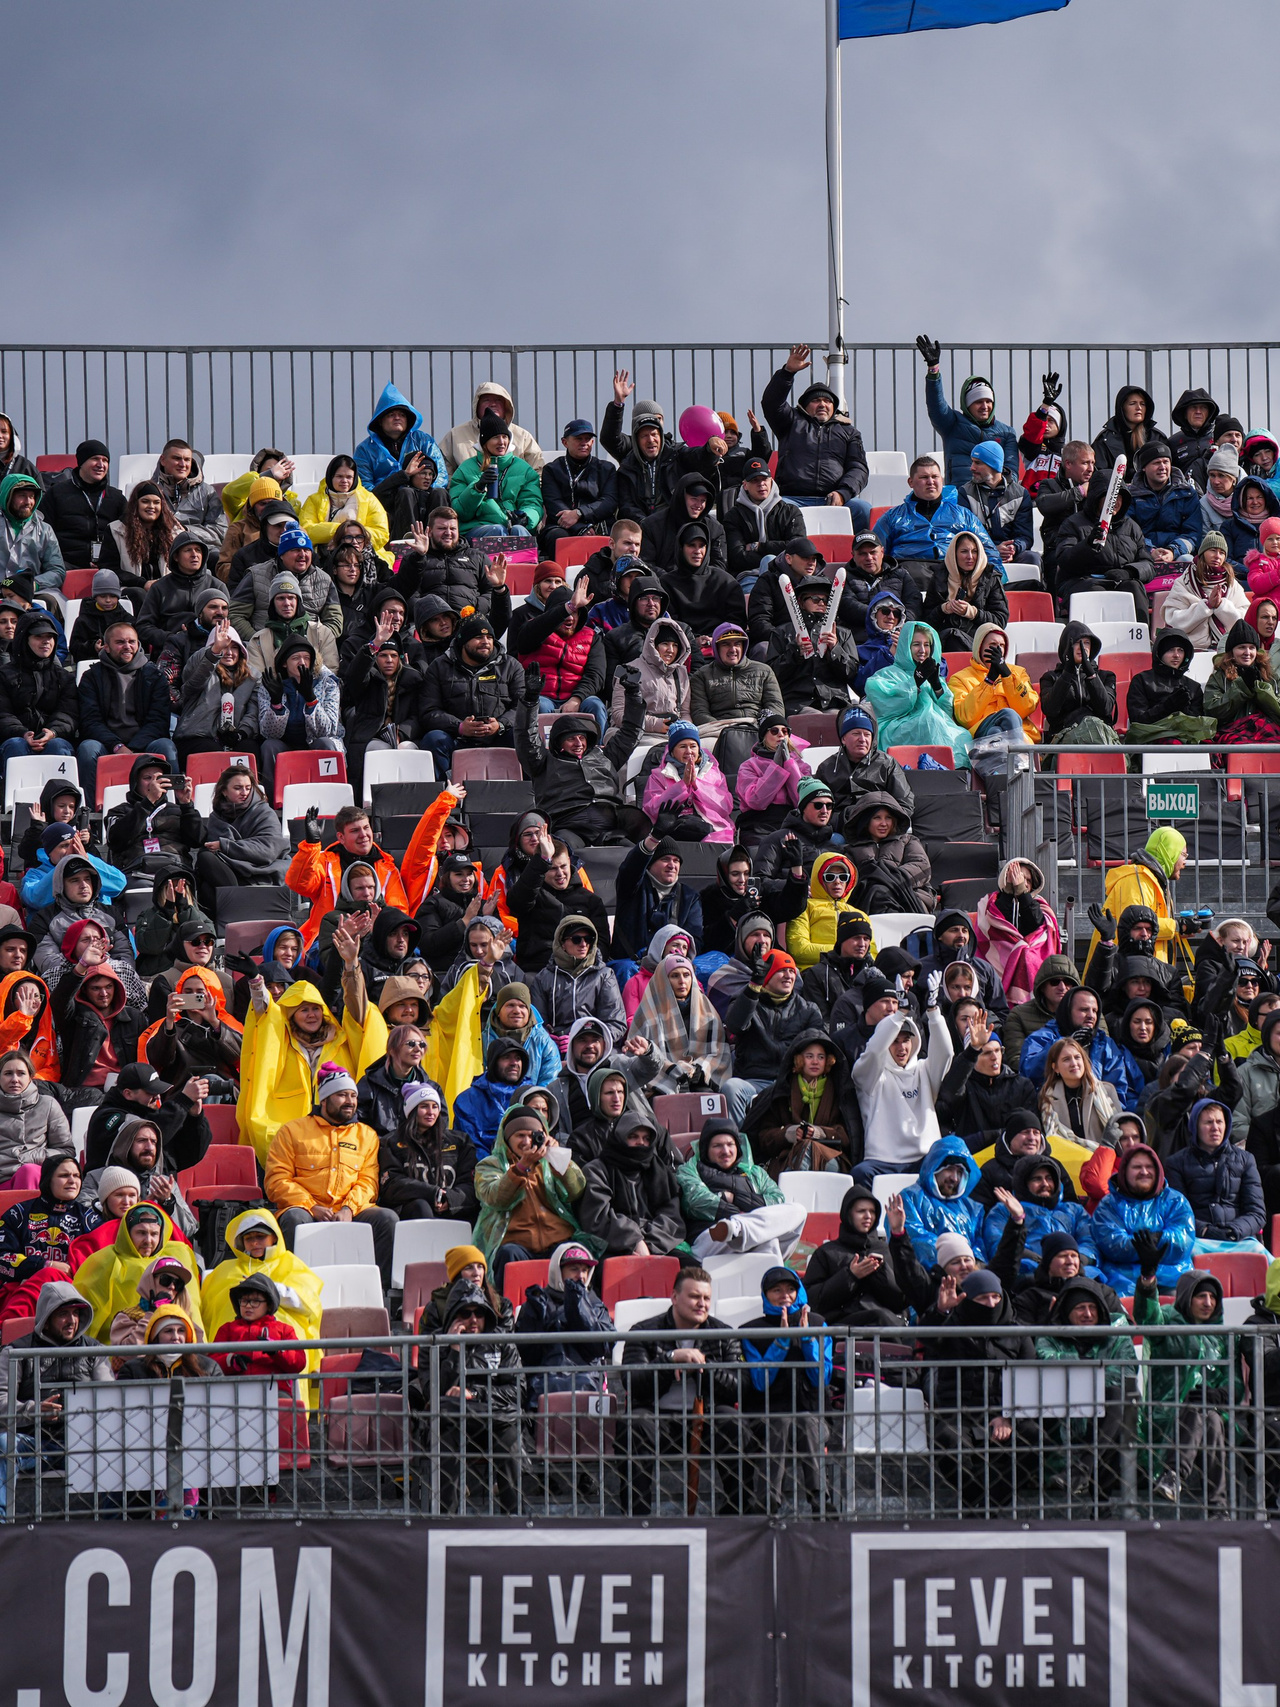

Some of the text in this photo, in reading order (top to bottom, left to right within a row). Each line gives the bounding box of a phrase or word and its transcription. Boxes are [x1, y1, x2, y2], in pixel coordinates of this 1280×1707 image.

[1128, 628, 1143, 640] 18
[58, 761, 66, 774] 4
[324, 760, 332, 773] 7
[1149, 793, 1196, 815] ВЫХОД
[706, 1098, 715, 1112] 9
[18, 1547, 332, 1707] .COM
[467, 1653, 664, 1687] KITCHEN
[894, 1654, 1086, 1689] KITCHEN
